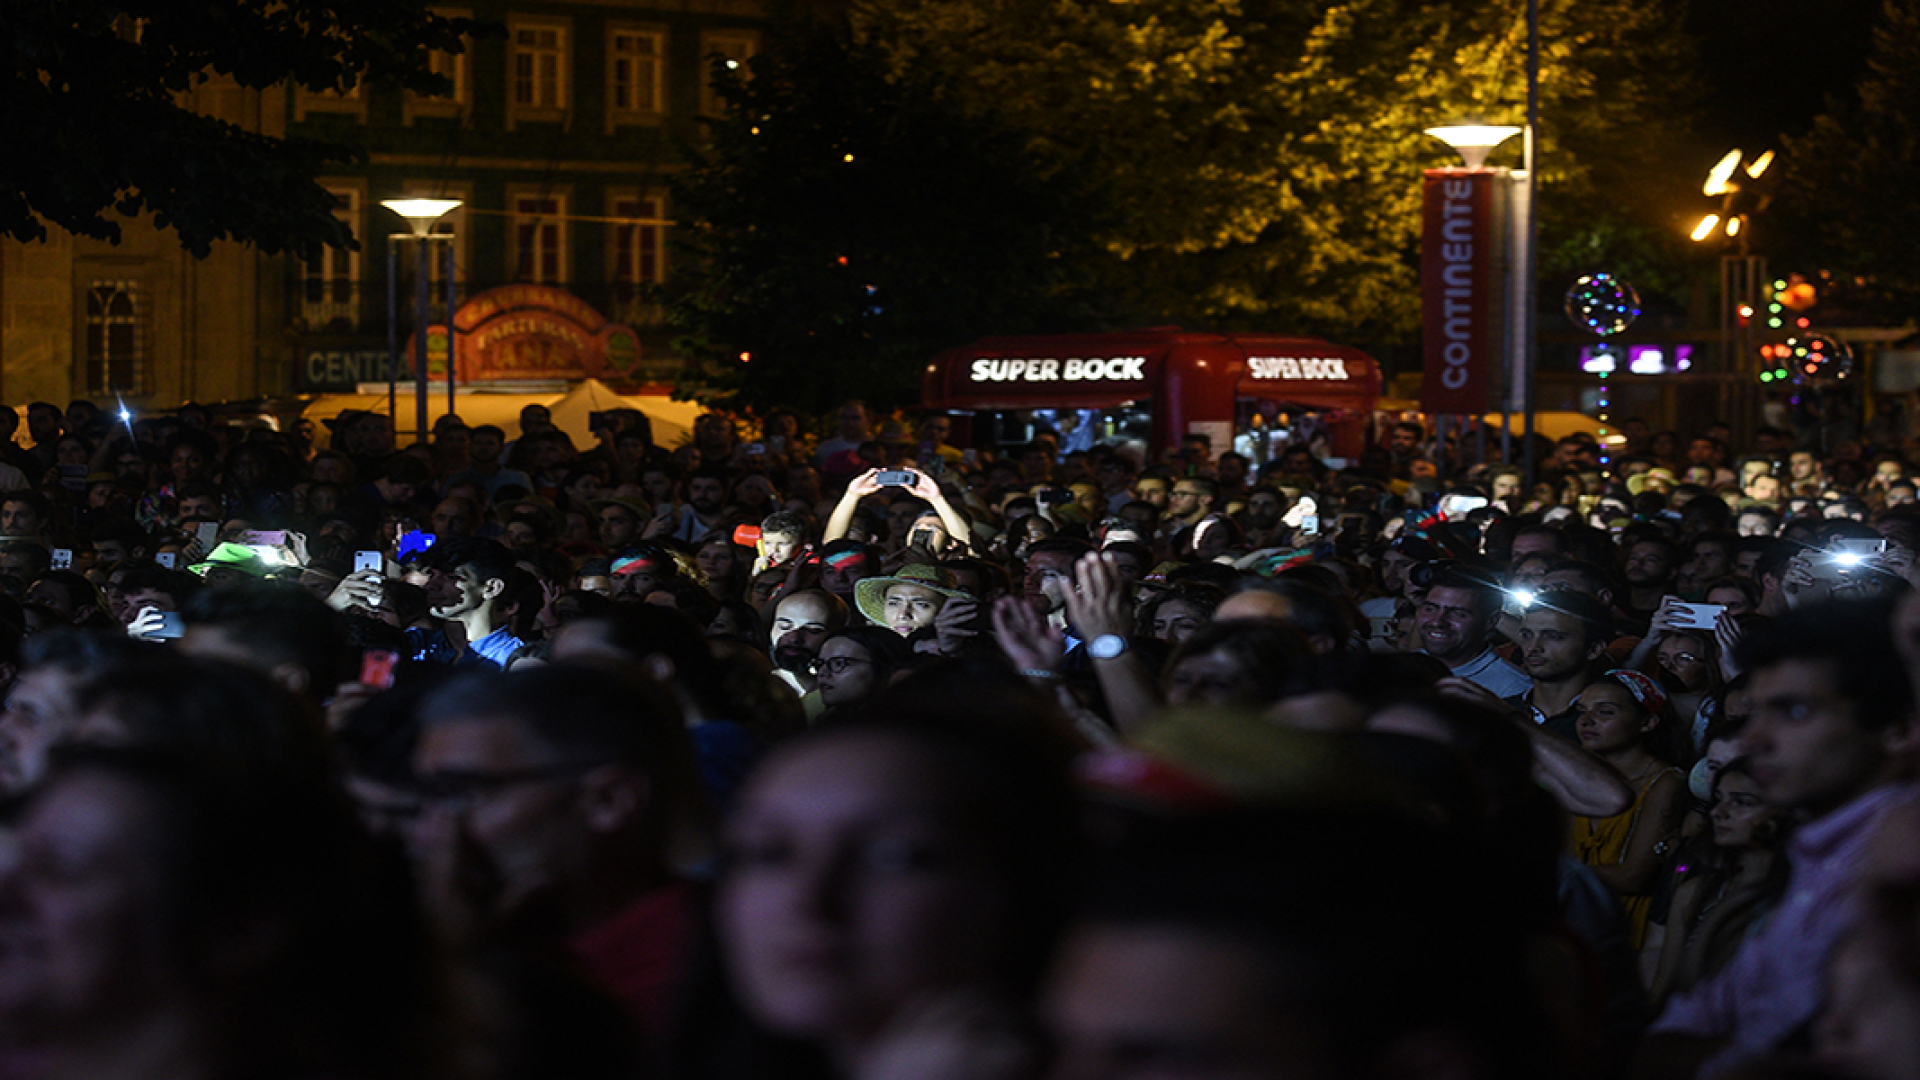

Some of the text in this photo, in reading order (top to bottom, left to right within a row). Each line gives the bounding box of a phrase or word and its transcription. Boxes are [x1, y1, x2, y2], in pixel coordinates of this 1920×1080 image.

[1441, 180, 1473, 389] CONTINENTE
[971, 357, 1144, 381] SUPER BOCK
[1248, 356, 1348, 380] SUPER BOCK
